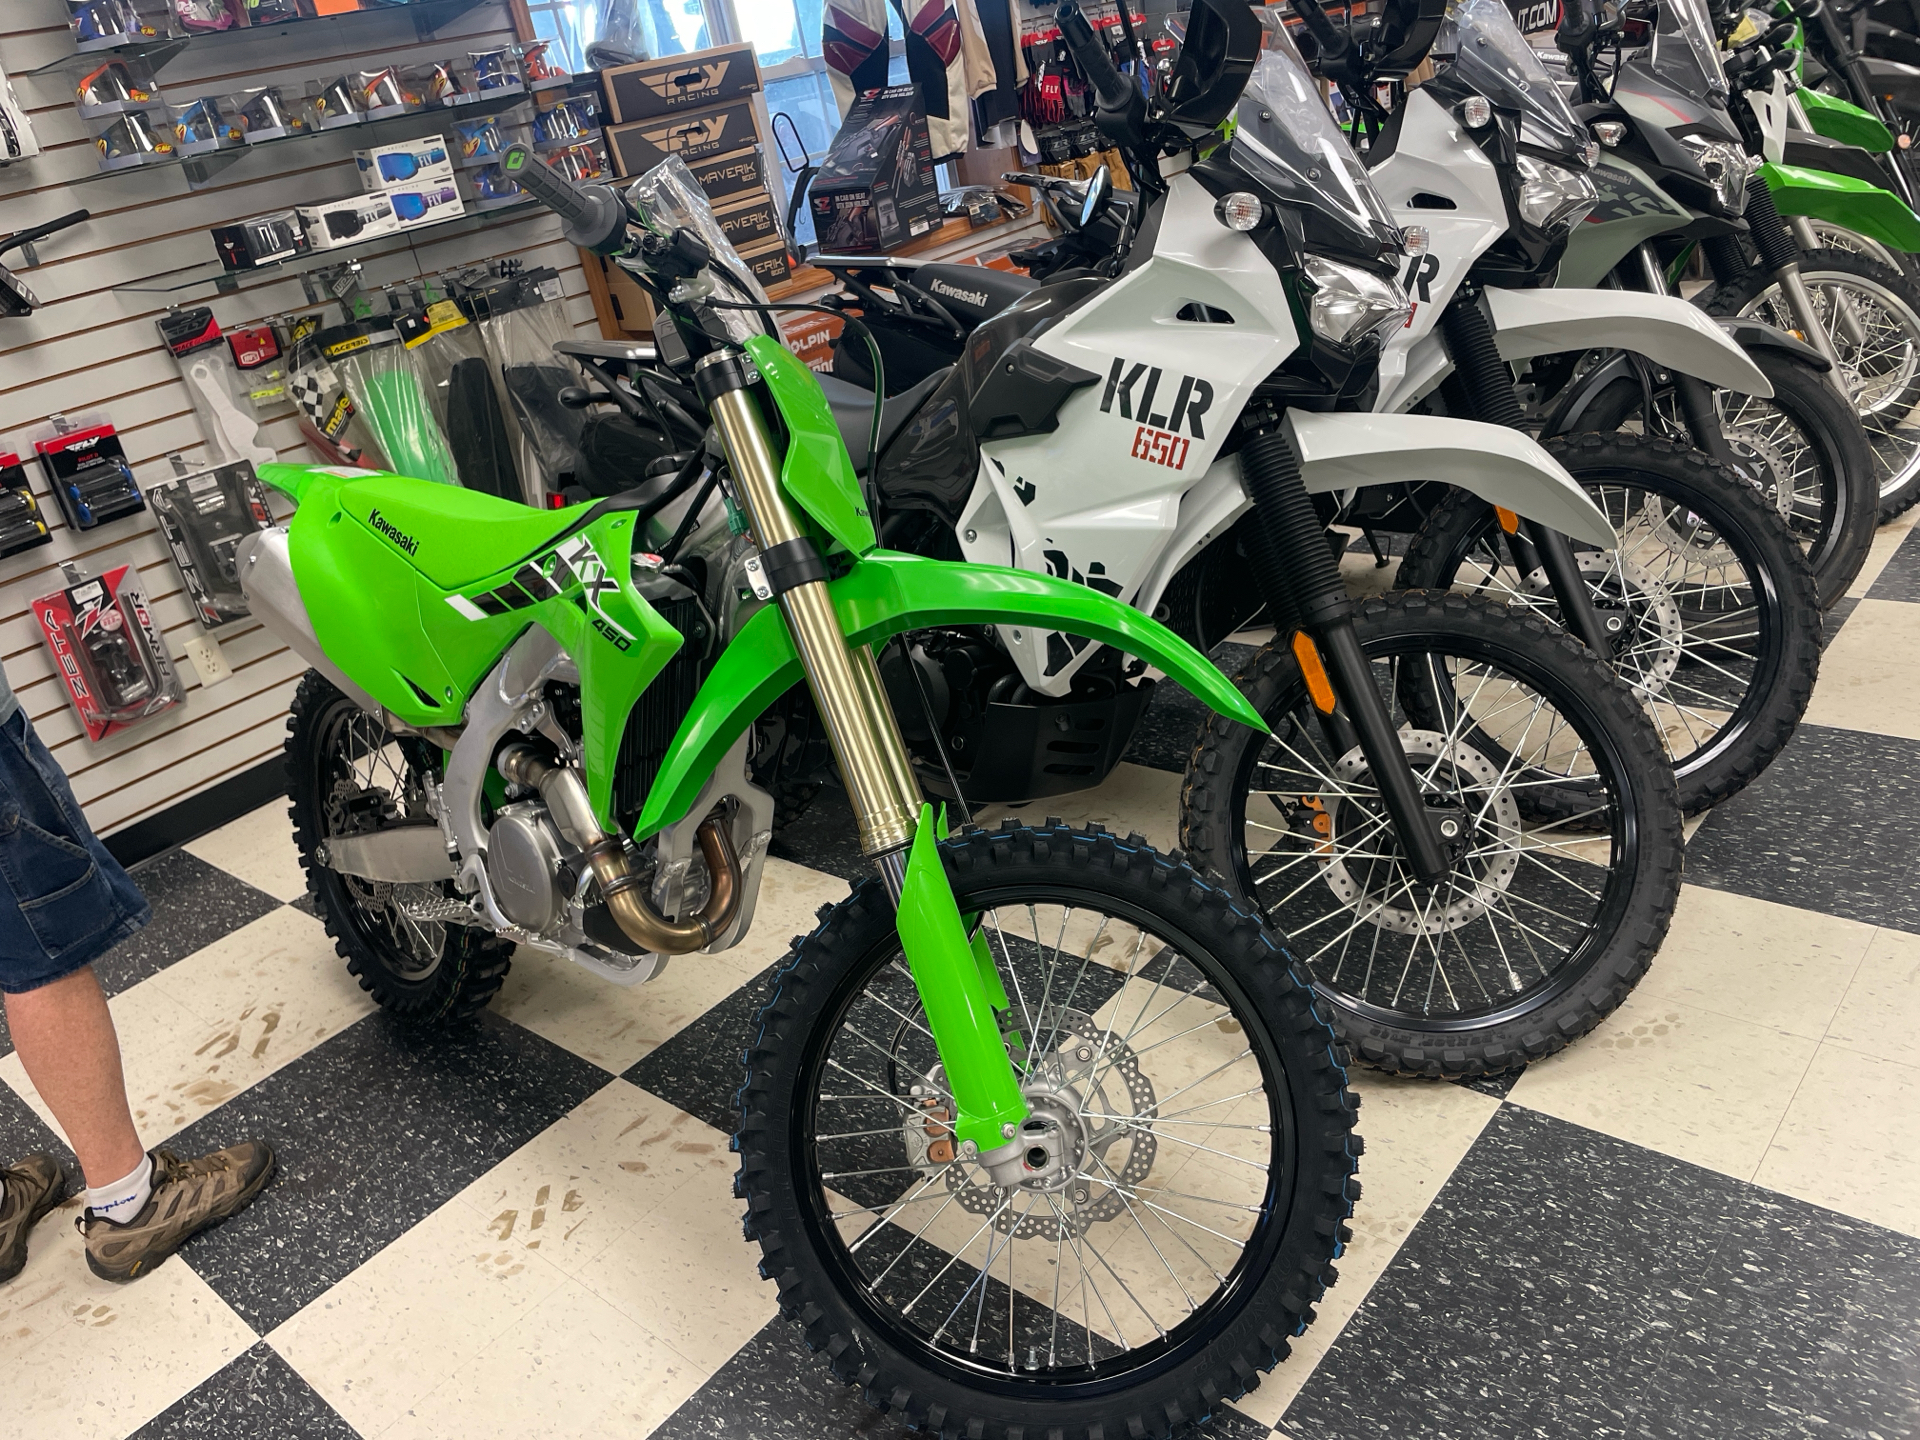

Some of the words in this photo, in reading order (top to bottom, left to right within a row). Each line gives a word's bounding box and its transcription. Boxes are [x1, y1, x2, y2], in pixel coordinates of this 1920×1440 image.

[666, 88, 719, 106] RACING
[1045, 84, 1059, 94] FLY
[680, 141, 720, 157] ACING
[418, 154, 433, 168] FLY
[698, 161, 756, 186] MAVERIK
[741, 172, 757, 182] BOOT
[1588, 167, 1632, 186] Kawasaki
[427, 193, 443, 208] FLY
[364, 211, 379, 224] FLY
[756, 221, 771, 231] BOOT
[770, 267, 786, 277] BOOT
[930, 278, 989, 308] Kawasaki
[790, 329, 831, 355] OLPIN
[1100, 356, 1214, 440] KLR
[325, 394, 351, 435] maie
[65, 436, 100, 452] FLY
[1131, 426, 1190, 471] 650
[78, 453, 93, 462] PILOT
[368, 508, 420, 557] Kawasaki
[567, 533, 621, 610] KX
[591, 619, 632, 652] 450
